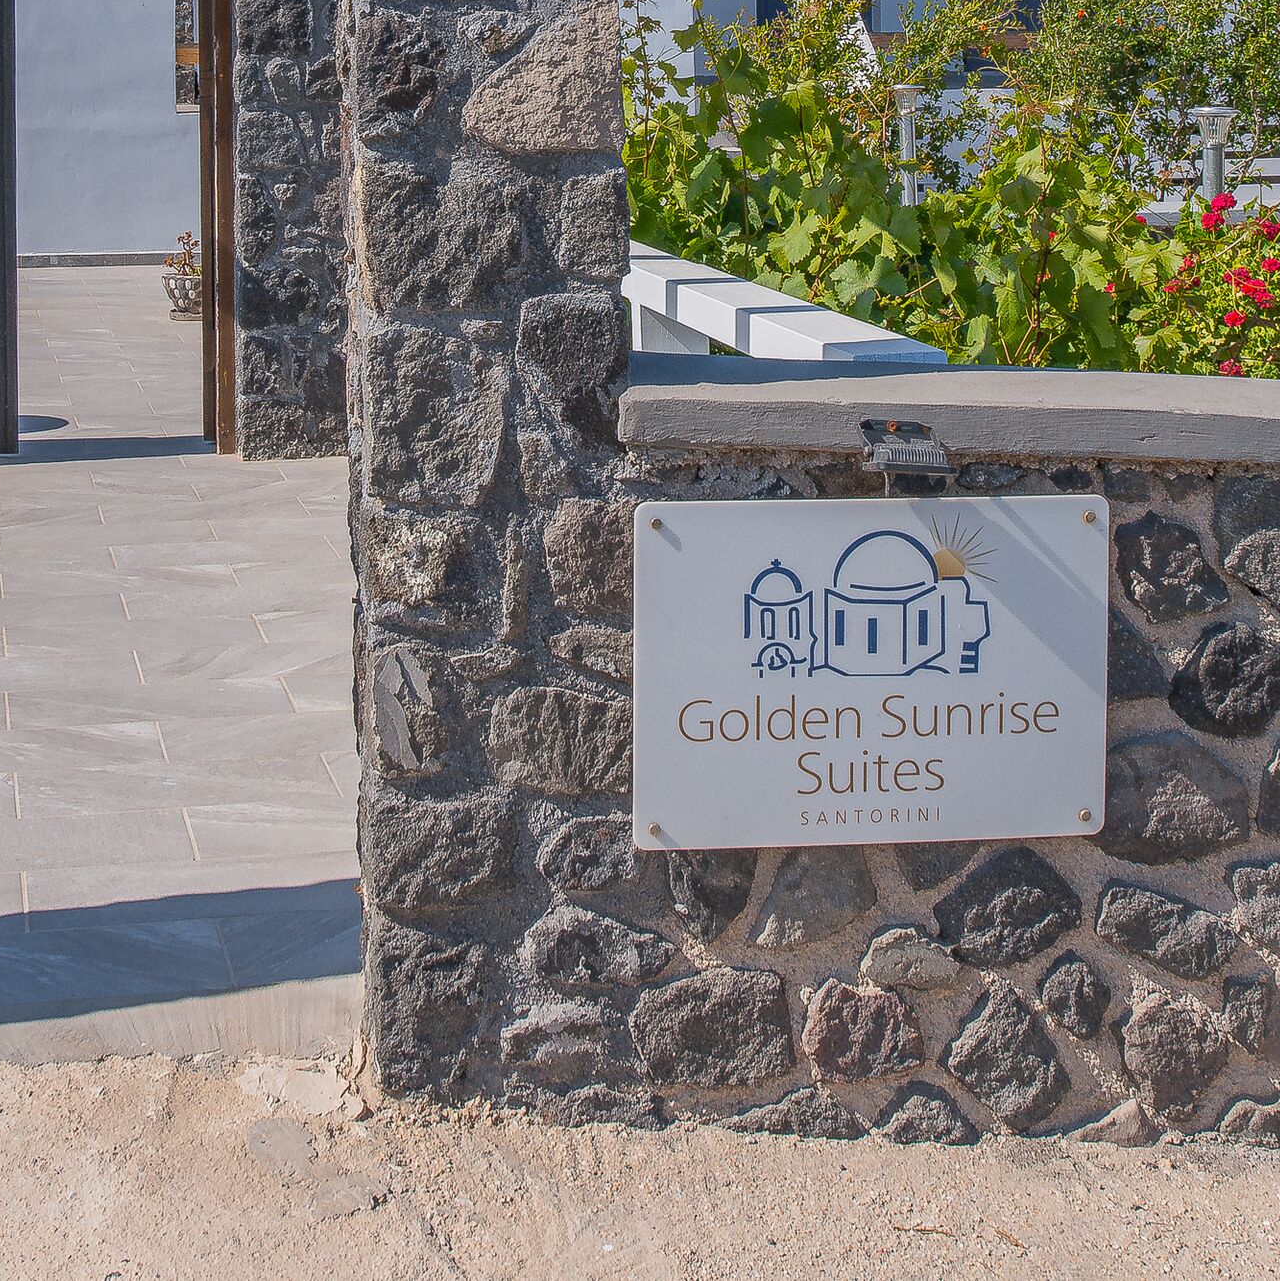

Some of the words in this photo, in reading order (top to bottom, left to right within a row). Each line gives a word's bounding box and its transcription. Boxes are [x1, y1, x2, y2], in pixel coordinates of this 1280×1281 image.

[678, 694, 862, 743] Golden
[881, 692, 1060, 739] Sunrise
[797, 750, 946, 796] Suites
[800, 807, 942, 826] SANTORINI
